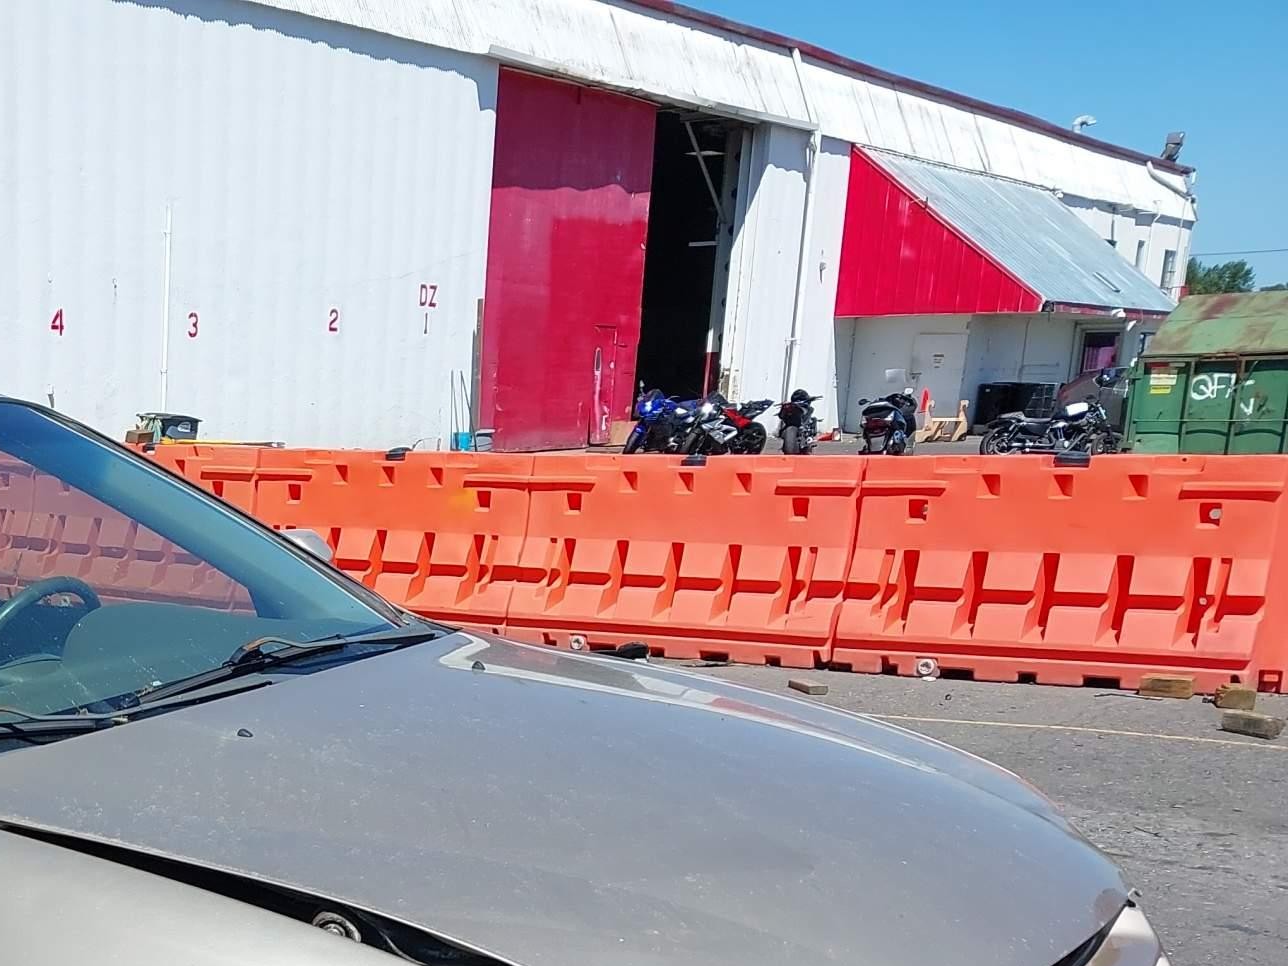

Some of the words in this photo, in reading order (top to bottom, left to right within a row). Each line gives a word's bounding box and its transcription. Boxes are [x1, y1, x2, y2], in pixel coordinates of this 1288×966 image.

[419, 284, 438, 308] DZ
[51, 309, 64, 336] 4
[188, 312, 199, 338] 3
[329, 309, 338, 331] 2
